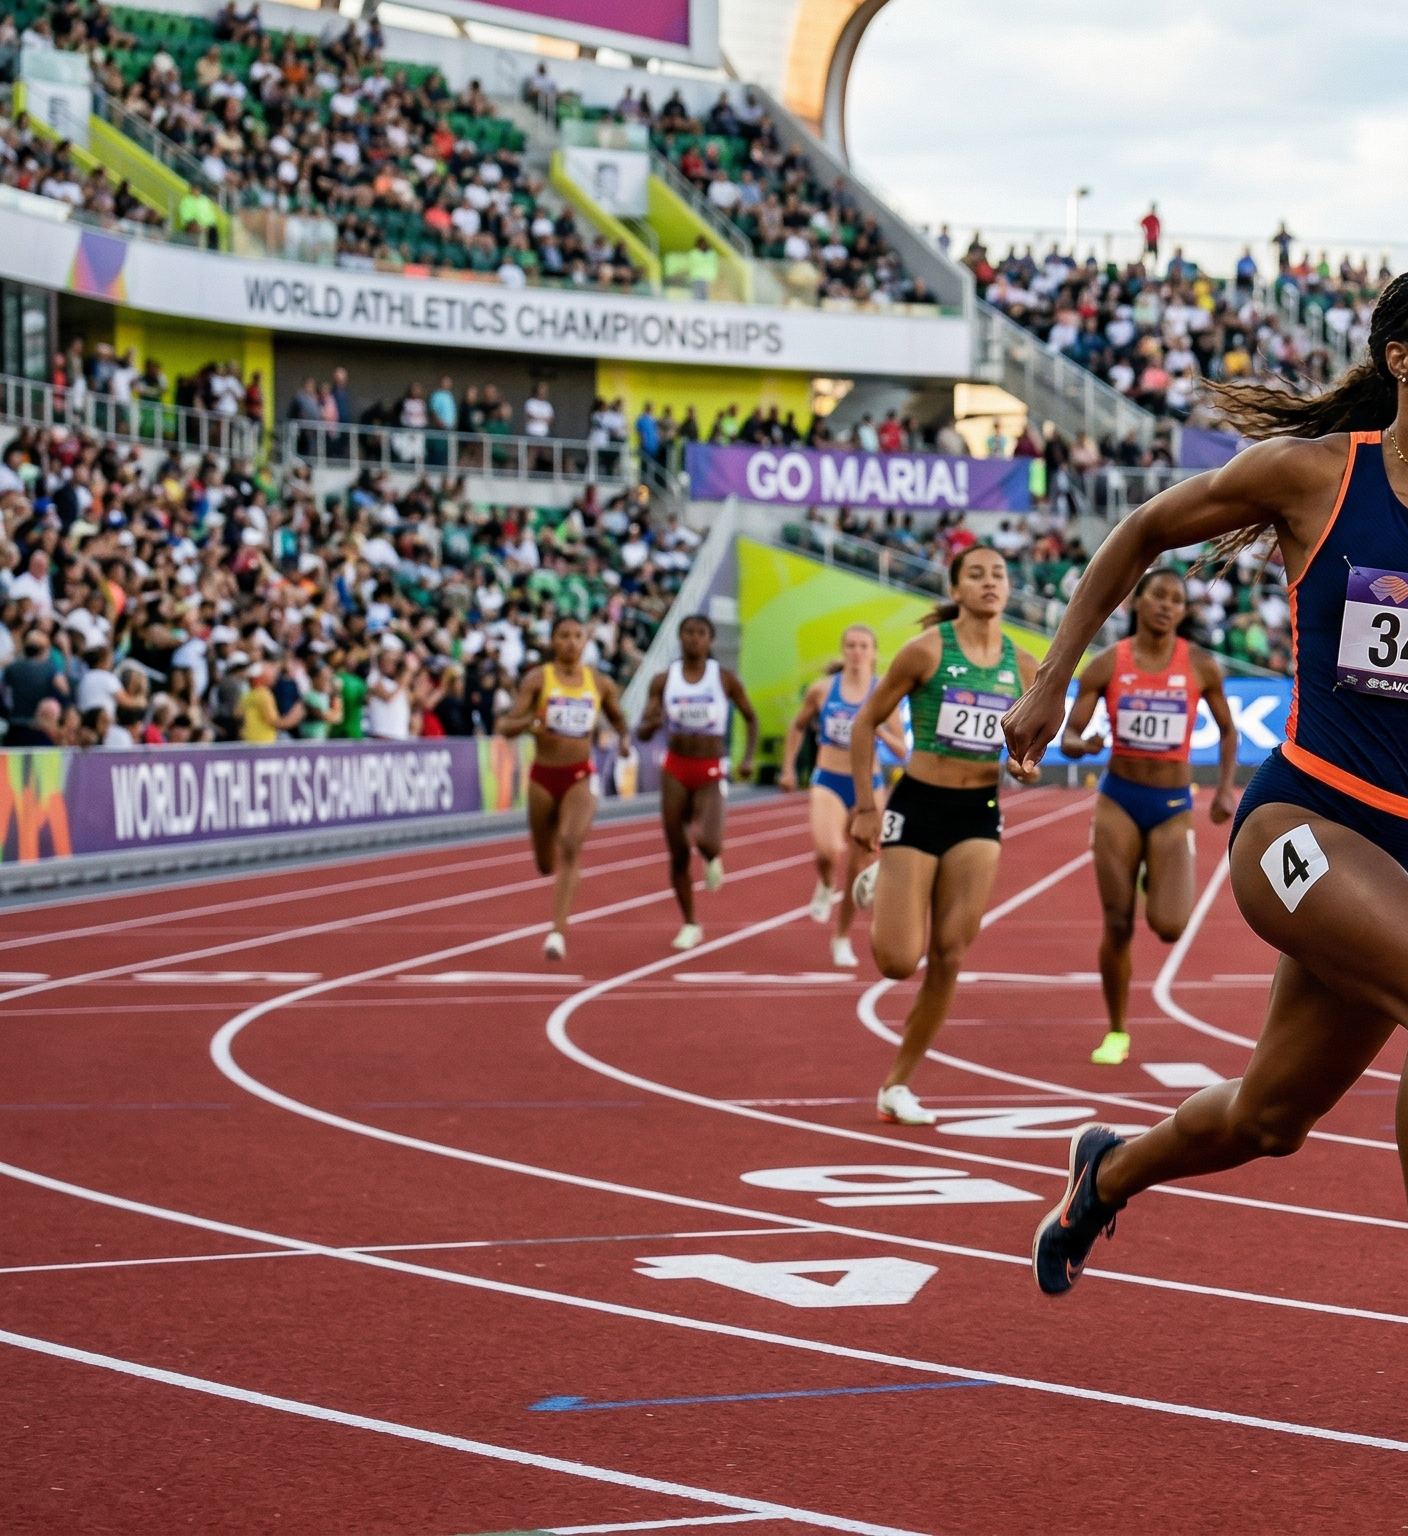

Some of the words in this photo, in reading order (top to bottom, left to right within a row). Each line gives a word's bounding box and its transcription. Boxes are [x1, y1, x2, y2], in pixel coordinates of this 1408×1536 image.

[245, 275, 344, 320] WORLD
[352, 288, 507, 336] ATHLETICS
[515, 304, 784, 354] CHAMPIONSHIPS
[746, 450, 814, 502] GO
[819, 454, 970, 508] MARIA!
[953, 710, 998, 739] 218
[1129, 715, 1170, 738] 401
[111, 760, 199, 841] WORLD
[200, 756, 314, 833] ATHLETICS
[313, 749, 454, 823] CHAMPIONSHIPS
[884, 815, 896, 838] 3
[1282, 839, 1311, 889] 4
[633, 1254, 940, 1307] 4
